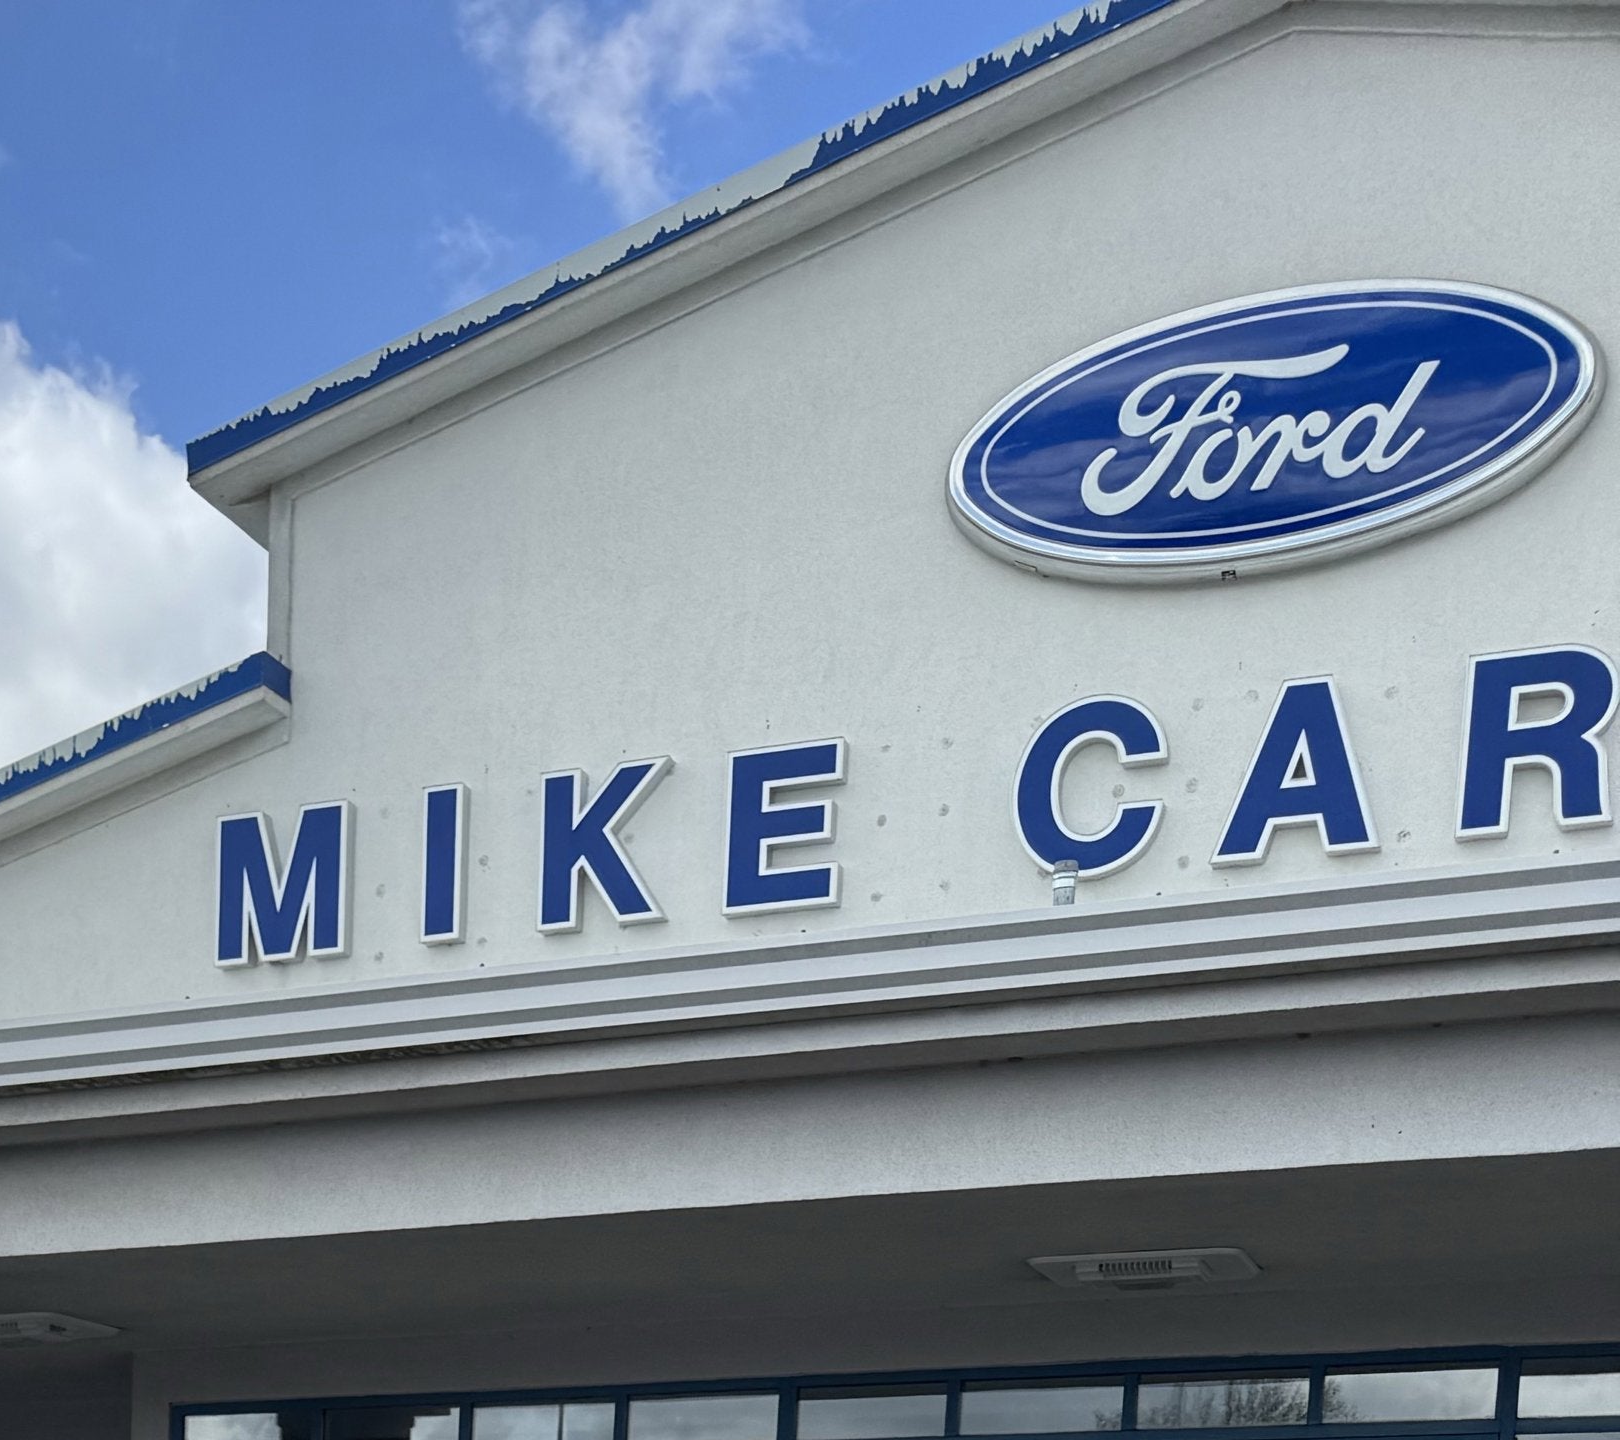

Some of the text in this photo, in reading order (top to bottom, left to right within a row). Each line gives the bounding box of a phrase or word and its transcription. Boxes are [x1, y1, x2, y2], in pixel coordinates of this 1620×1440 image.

[1081, 343, 1441, 518] Ford
[214, 643, 1620, 969] MIKE CAR
